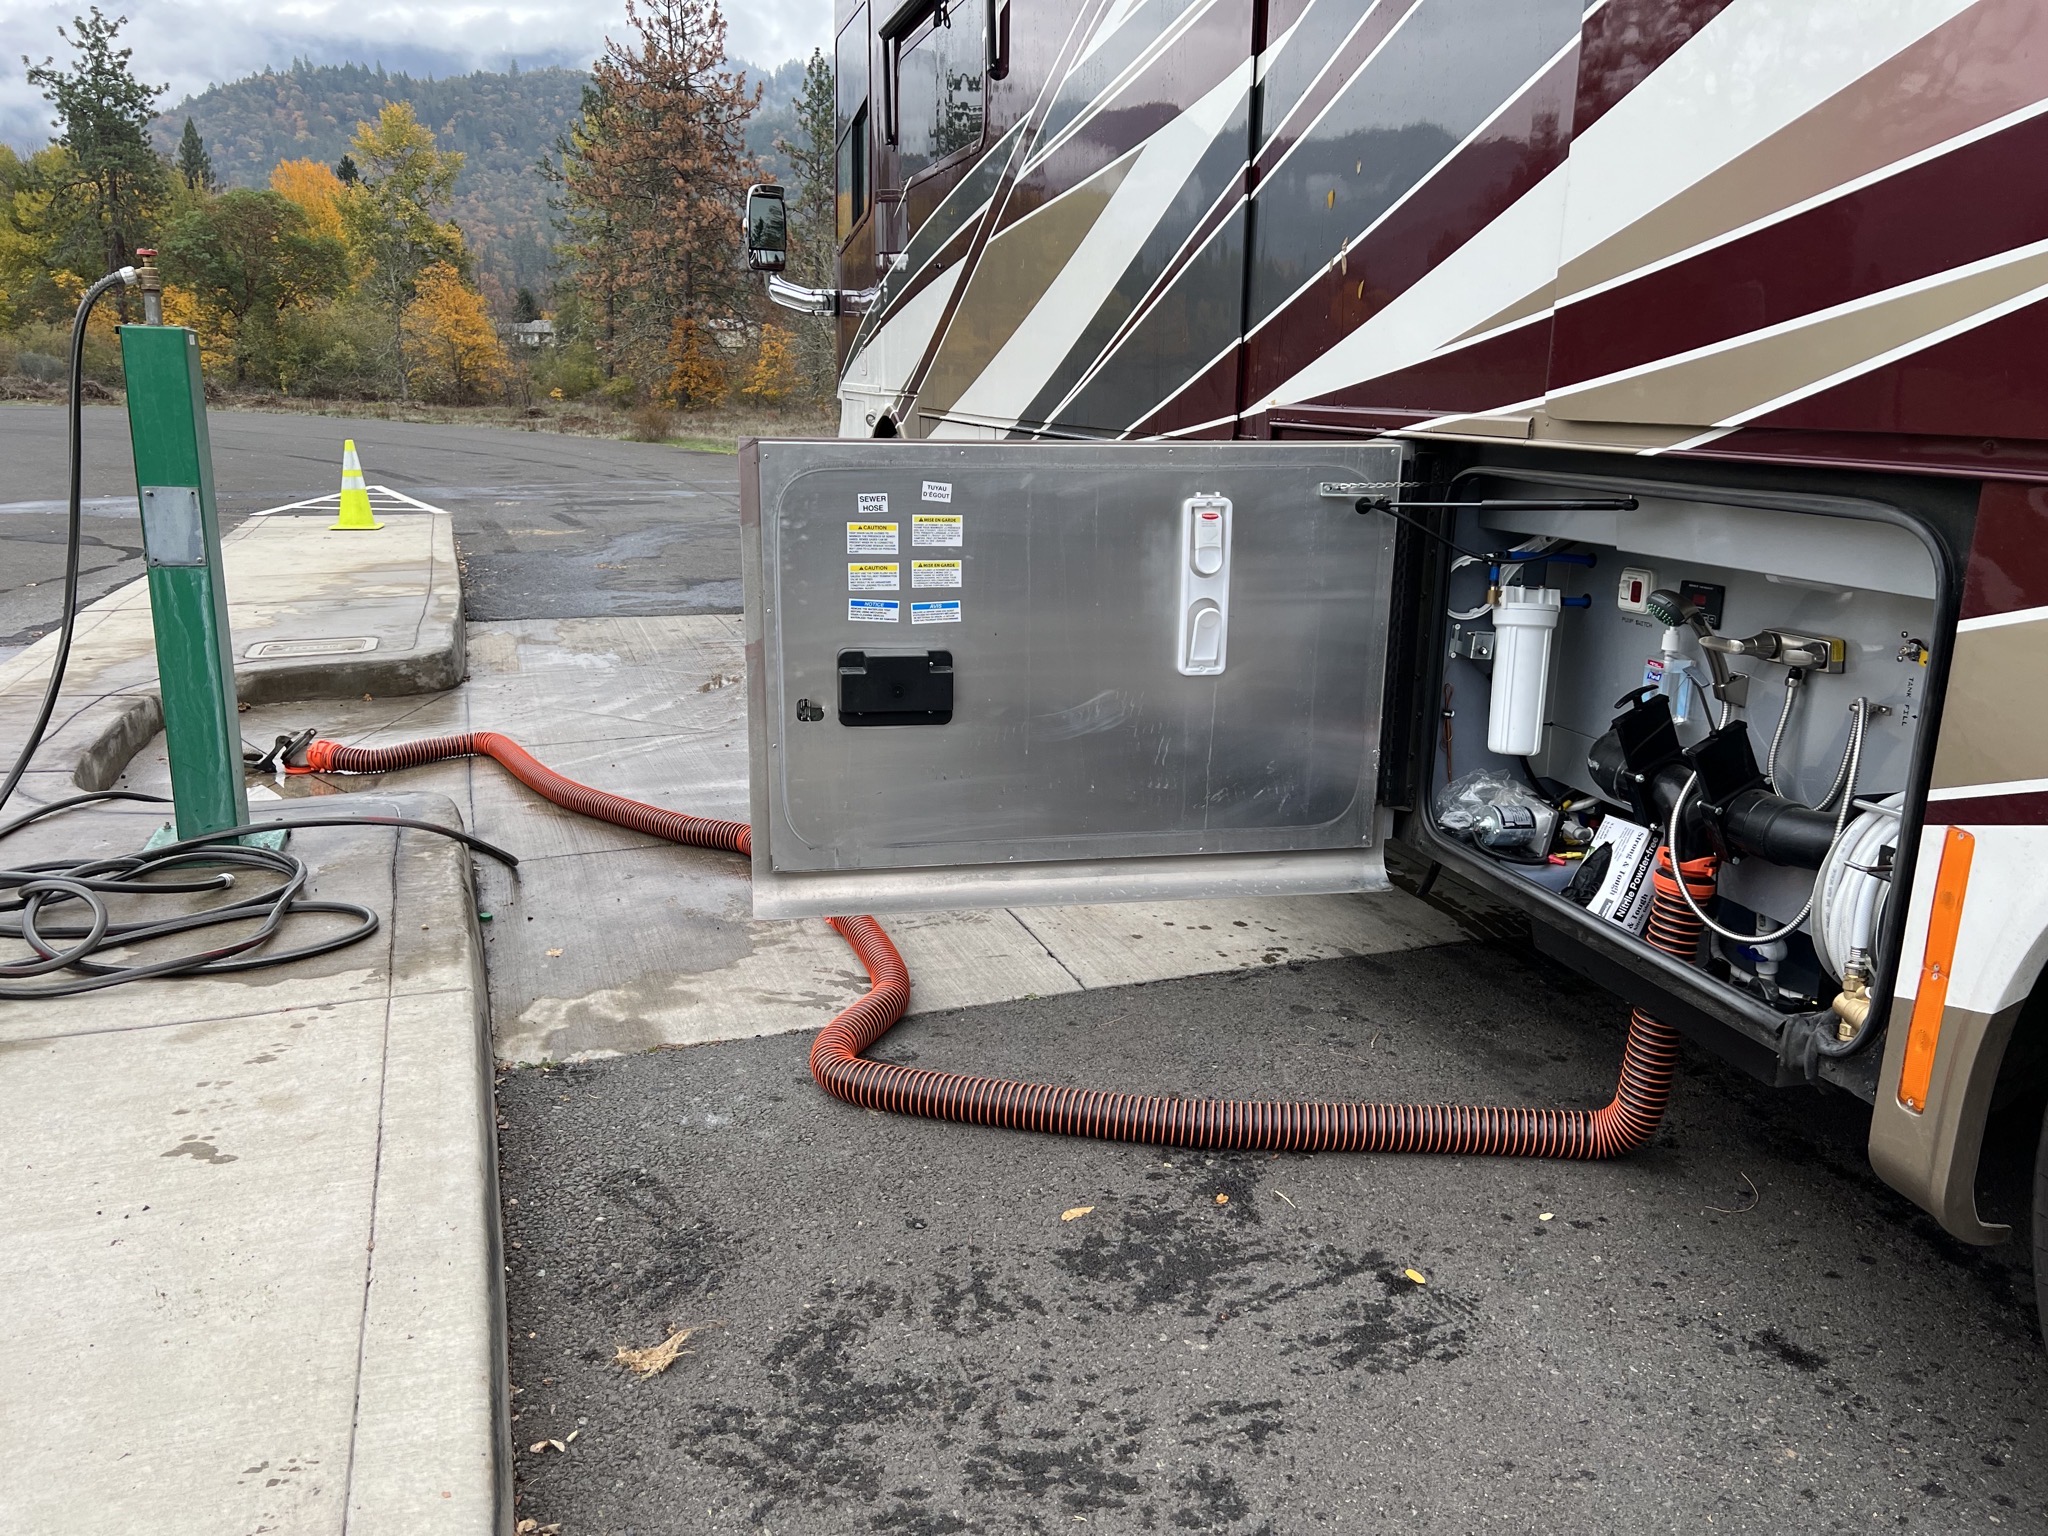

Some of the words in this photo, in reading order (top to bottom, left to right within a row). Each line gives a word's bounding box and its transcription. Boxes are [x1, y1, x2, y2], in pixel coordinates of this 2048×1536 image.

[859, 495, 887, 503] SEWER
[927, 484, 947, 492] TUYAU
[862, 504, 884, 512] HOSE
[1906, 677, 1914, 698] TANK
[1901, 704, 1910, 726] FILL
[1627, 831, 1645, 860] Strong
[1610, 870, 1626, 896] Tough
[1616, 891, 1635, 918] Nitrile
[1630, 837, 1659, 891] Powder-free
[1627, 921, 1634, 929] &
[1631, 893, 1648, 920] Tough
